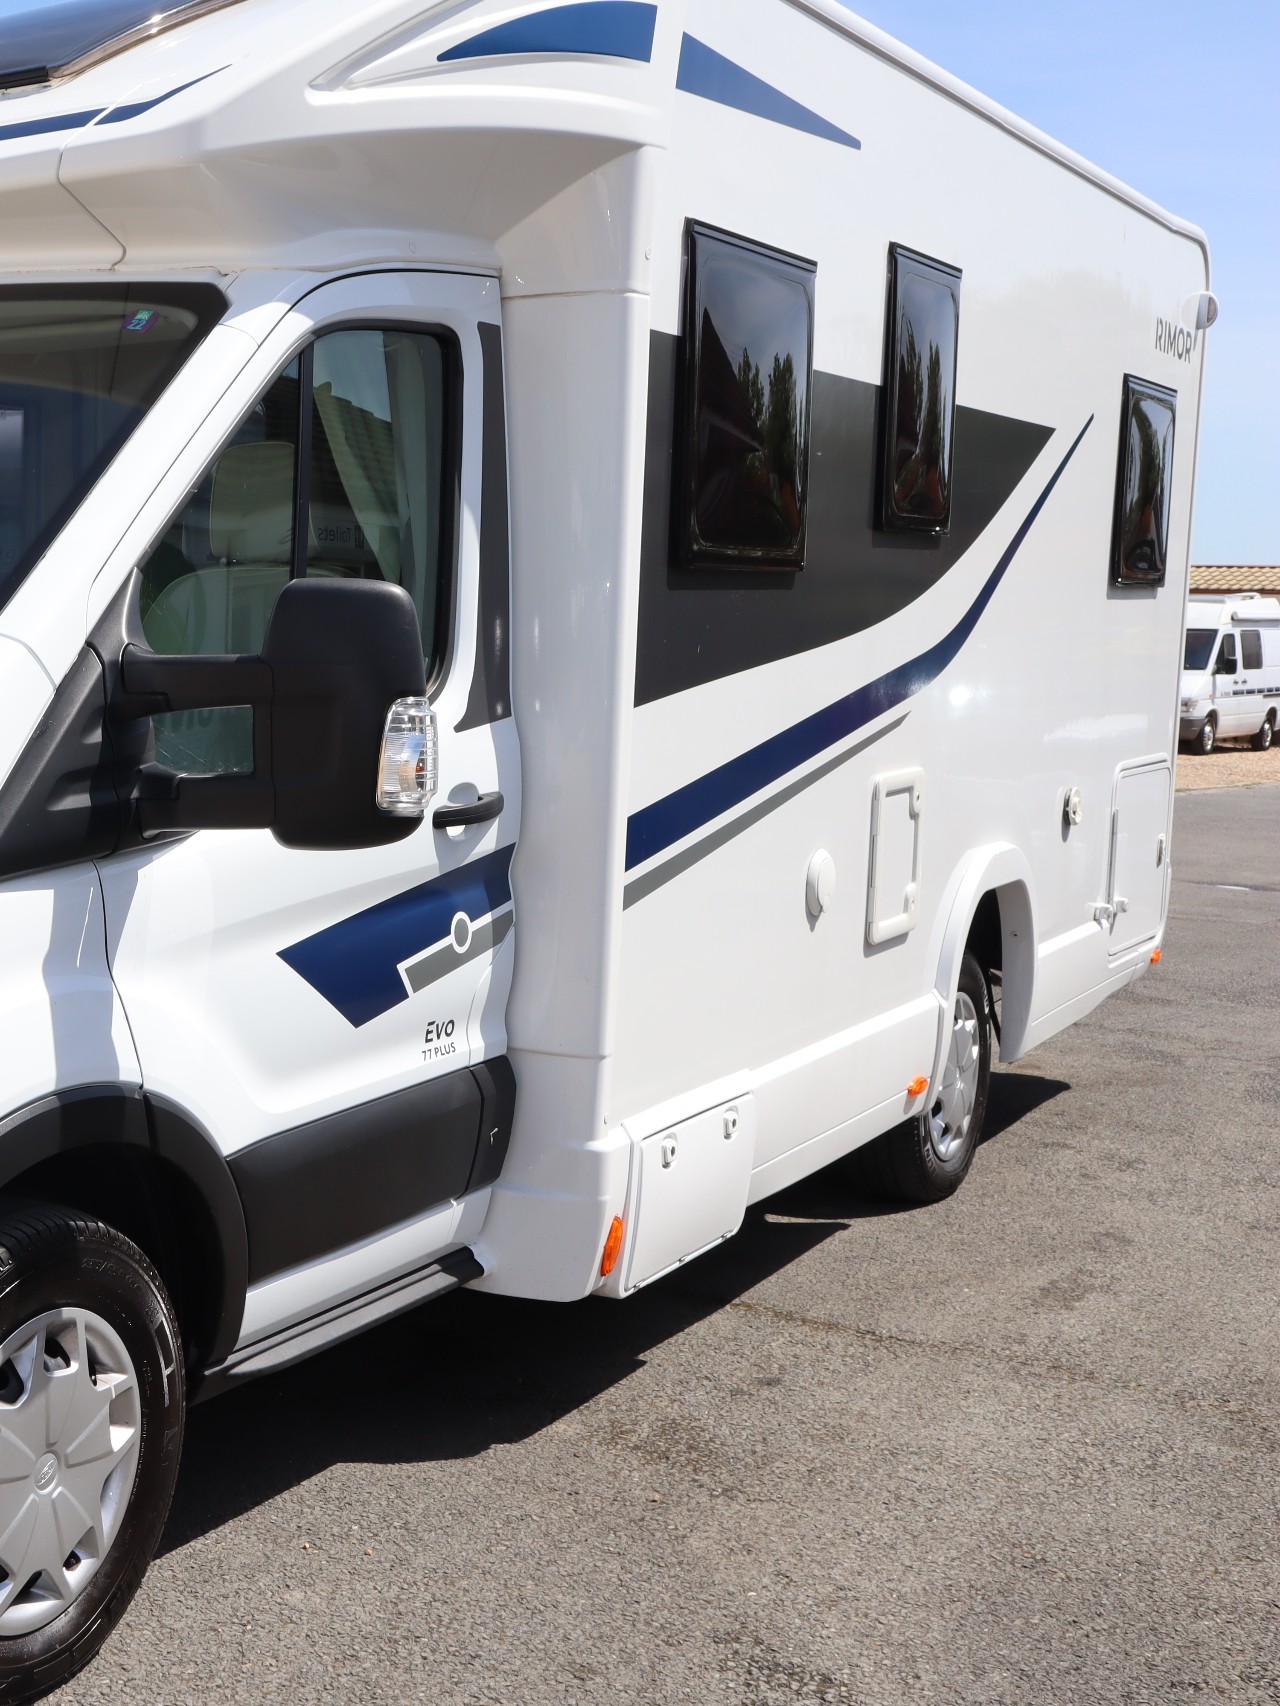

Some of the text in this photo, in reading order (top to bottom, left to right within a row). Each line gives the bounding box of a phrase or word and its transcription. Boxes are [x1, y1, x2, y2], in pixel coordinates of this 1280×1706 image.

[1155, 317, 1192, 364] RIMOR
[424, 1019, 455, 1044] EVO
[422, 1042, 456, 1062] 77 PLUS
